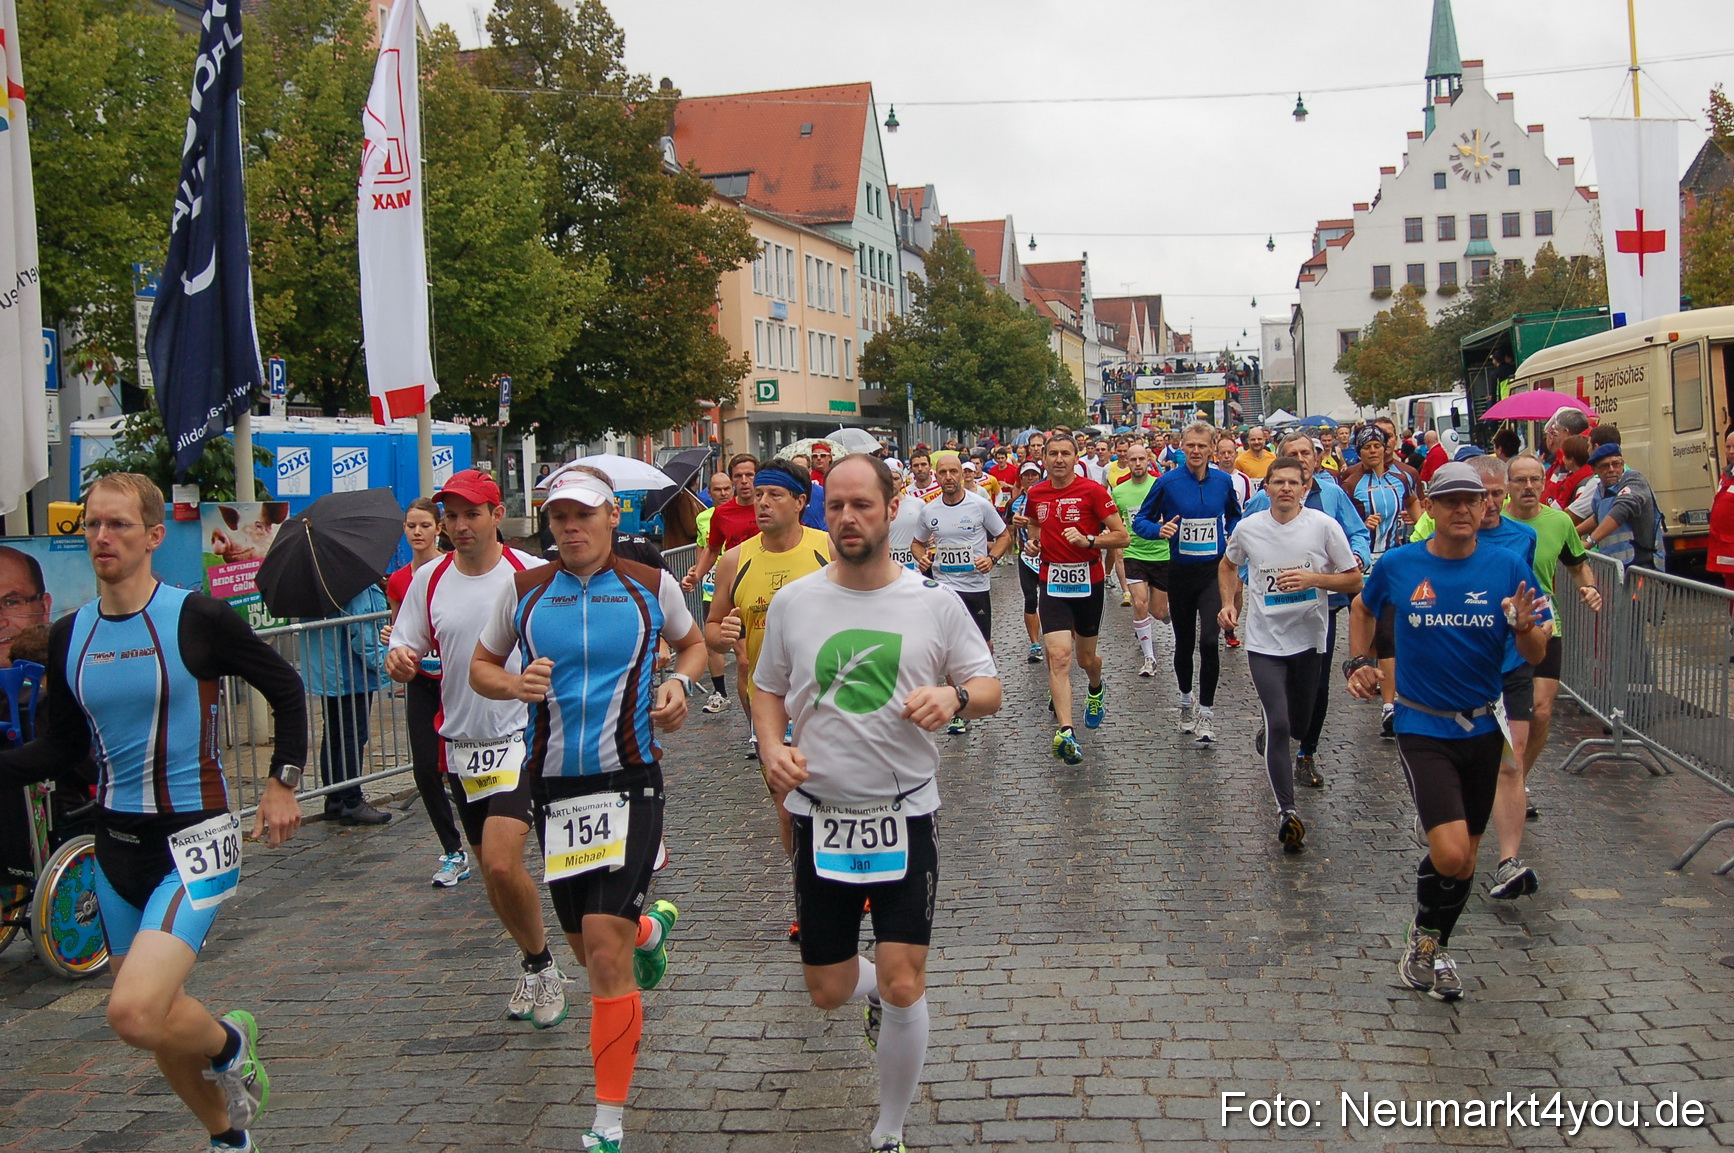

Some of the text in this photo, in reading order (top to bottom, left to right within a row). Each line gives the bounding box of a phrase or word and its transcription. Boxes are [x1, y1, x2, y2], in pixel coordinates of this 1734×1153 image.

[273, 363, 283, 391] P
[1594, 364, 1645, 393] Bayerisches
[502, 380, 509, 402] P
[759, 383, 775, 399] D
[1165, 391, 1195, 400] START
[1594, 396, 1618, 414] Rotes
[1672, 443, 1702, 458] Bayerisches
[1183, 527, 1214, 541] 3174
[941, 551, 971, 564] 2013
[226, 562, 260, 572] SEPTEMBER
[212, 572, 257, 587] BEIDE STIM
[1052, 568, 1086, 583] 2963
[232, 581, 255, 592] GRÜN
[1425, 614, 1494, 627] BARCLAYS
[454, 737, 512, 749] PARTL Neumarkt
[466, 748, 509, 774] 497
[547, 802, 612, 820] PARTL Neumarkt
[815, 804, 888, 815] PARTL Neumarkt
[563, 813, 611, 848] 154
[823, 816, 898, 849] 2750
[172, 833, 204, 849] PARTL
[185, 833, 239, 875] 3198
[565, 849, 606, 867] Michael
[850, 858, 870, 871] Jan
